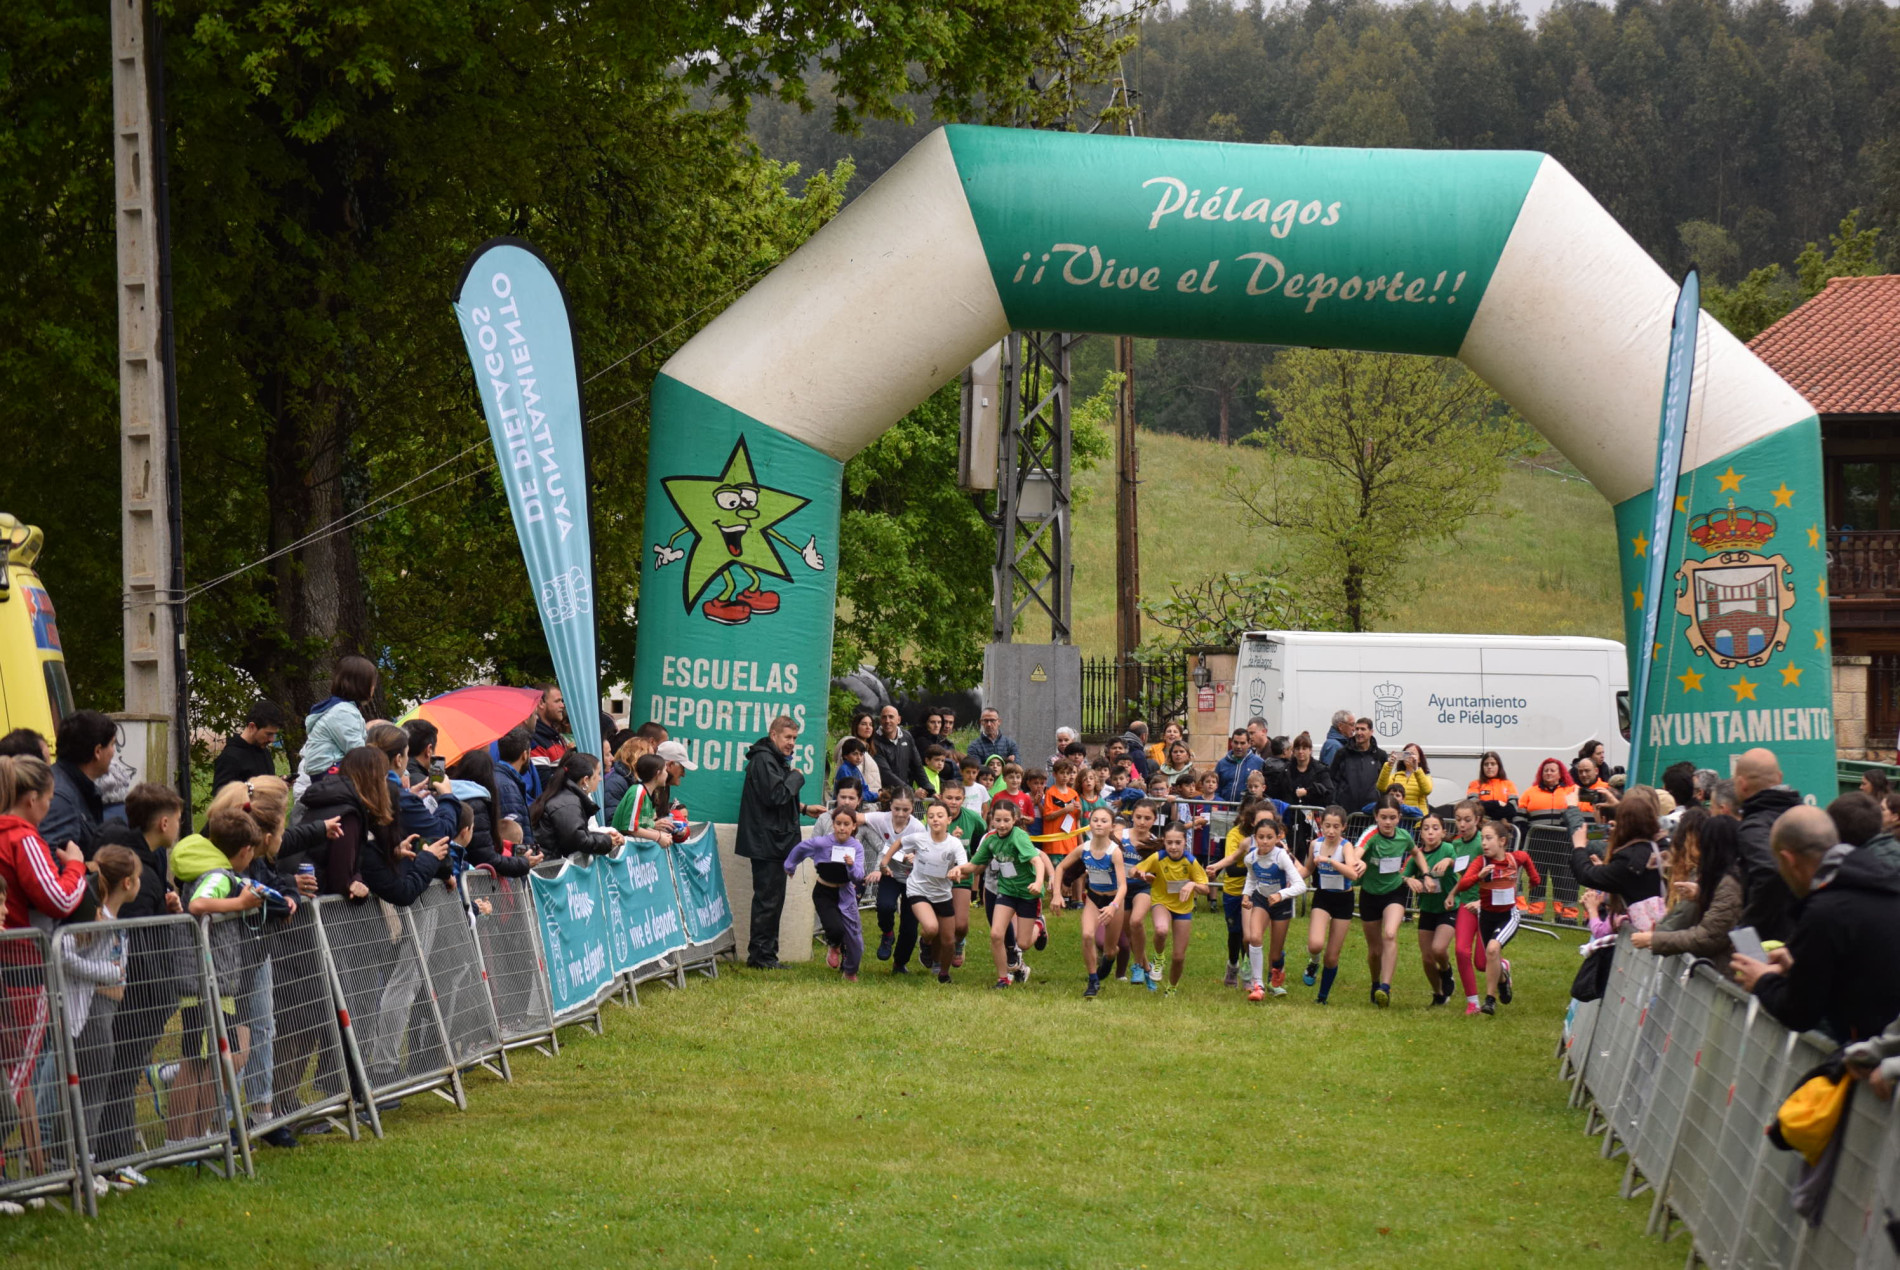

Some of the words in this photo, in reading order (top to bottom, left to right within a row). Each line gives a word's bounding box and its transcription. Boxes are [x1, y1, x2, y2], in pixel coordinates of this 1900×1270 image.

[1142, 176, 1342, 239] Piélagos
[1013, 243, 1160, 290] ¡¡Vive
[1176, 260, 1219, 294] el
[1235, 252, 1468, 313] Deporte!!
[662, 656, 799, 694] ESCUELAS
[1428, 693, 1527, 711] Ayuntamiento
[1438, 710, 1455, 723] de
[1460, 710, 1518, 728] Piélagos
[1650, 707, 1831, 747] AYUNTAMIENTO
